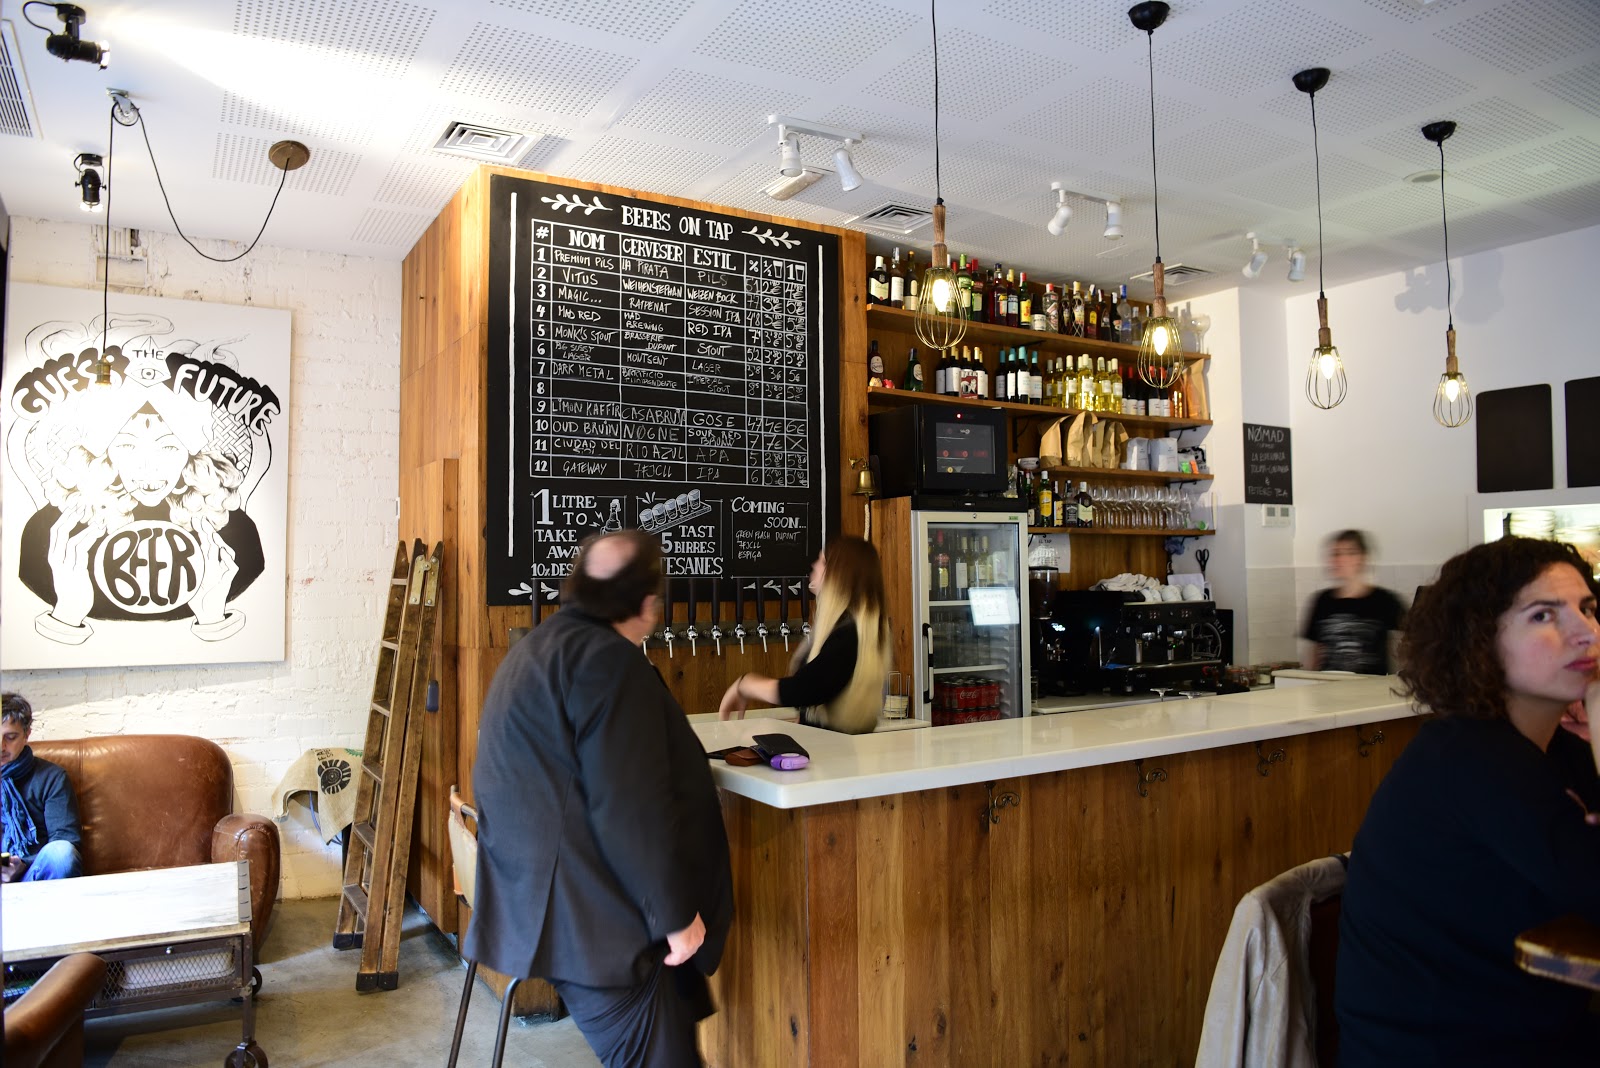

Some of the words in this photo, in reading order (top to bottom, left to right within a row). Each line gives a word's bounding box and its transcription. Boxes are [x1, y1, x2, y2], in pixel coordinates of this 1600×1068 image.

[621, 204, 671, 231] BEERS
[679, 216, 700, 236] ON
[706, 220, 734, 240] TAP
[536, 226, 550, 240] #
[568, 229, 606, 250] NOM
[622, 238, 683, 262] CERVESER
[693, 248, 736, 270] ESTIL
[537, 248, 546, 261] 1
[537, 267, 546, 279] 2
[622, 259, 631, 270] LA
[637, 260, 669, 279] PIRATA
[562, 268, 598, 286] VITUS
[536, 283, 546, 298] 3
[687, 287, 714, 301] WEIZEN
[716, 292, 738, 304] BOCK
[536, 304, 546, 318] 4
[558, 306, 575, 319] MAD
[578, 310, 601, 322] RED
[624, 312, 641, 320] MAD
[689, 304, 722, 319] SESSION
[725, 310, 741, 324] IPA
[536, 324, 546, 337] 5
[591, 330, 618, 344] STOUT
[688, 322, 708, 336] RED
[713, 324, 732, 338] IPA
[536, 343, 546, 355] 6
[646, 342, 678, 352] DUPONT
[697, 342, 732, 357] STOUT
[537, 362, 546, 374] 7
[552, 362, 574, 376] DARK
[578, 364, 614, 380] METAL
[692, 360, 722, 375] LAGER
[132, 349, 164, 360] THE
[173, 363, 281, 436] FUTURE
[536, 382, 545, 394] 8
[536, 400, 546, 413] 9
[534, 419, 548, 432] 10
[552, 420, 579, 432] OUD
[692, 412, 735, 428] GOSE
[688, 428, 716, 438] SOUR
[721, 430, 742, 440] RED
[1248, 426, 1284, 442] NØMAD
[534, 439, 548, 452] 11
[554, 438, 596, 448] CIUDAD
[600, 440, 620, 450] DEL
[626, 443, 648, 458] RIO
[652, 444, 684, 460] AZUL
[696, 448, 730, 462] APA
[534, 460, 548, 472] 12
[563, 460, 608, 476] GATEWAY
[696, 467, 720, 480] IPA
[751, 470, 759, 483] 6
[534, 488, 554, 525] 1
[552, 495, 597, 508] LITRE
[731, 496, 784, 514] COMING
[563, 512, 588, 525] TO
[534, 529, 578, 542] TAKE
[679, 526, 715, 538] TAST
[661, 532, 672, 554] 5
[674, 542, 716, 554] BIRRES
[546, 546, 584, 558] AWA
[103, 527, 196, 606] BEER
